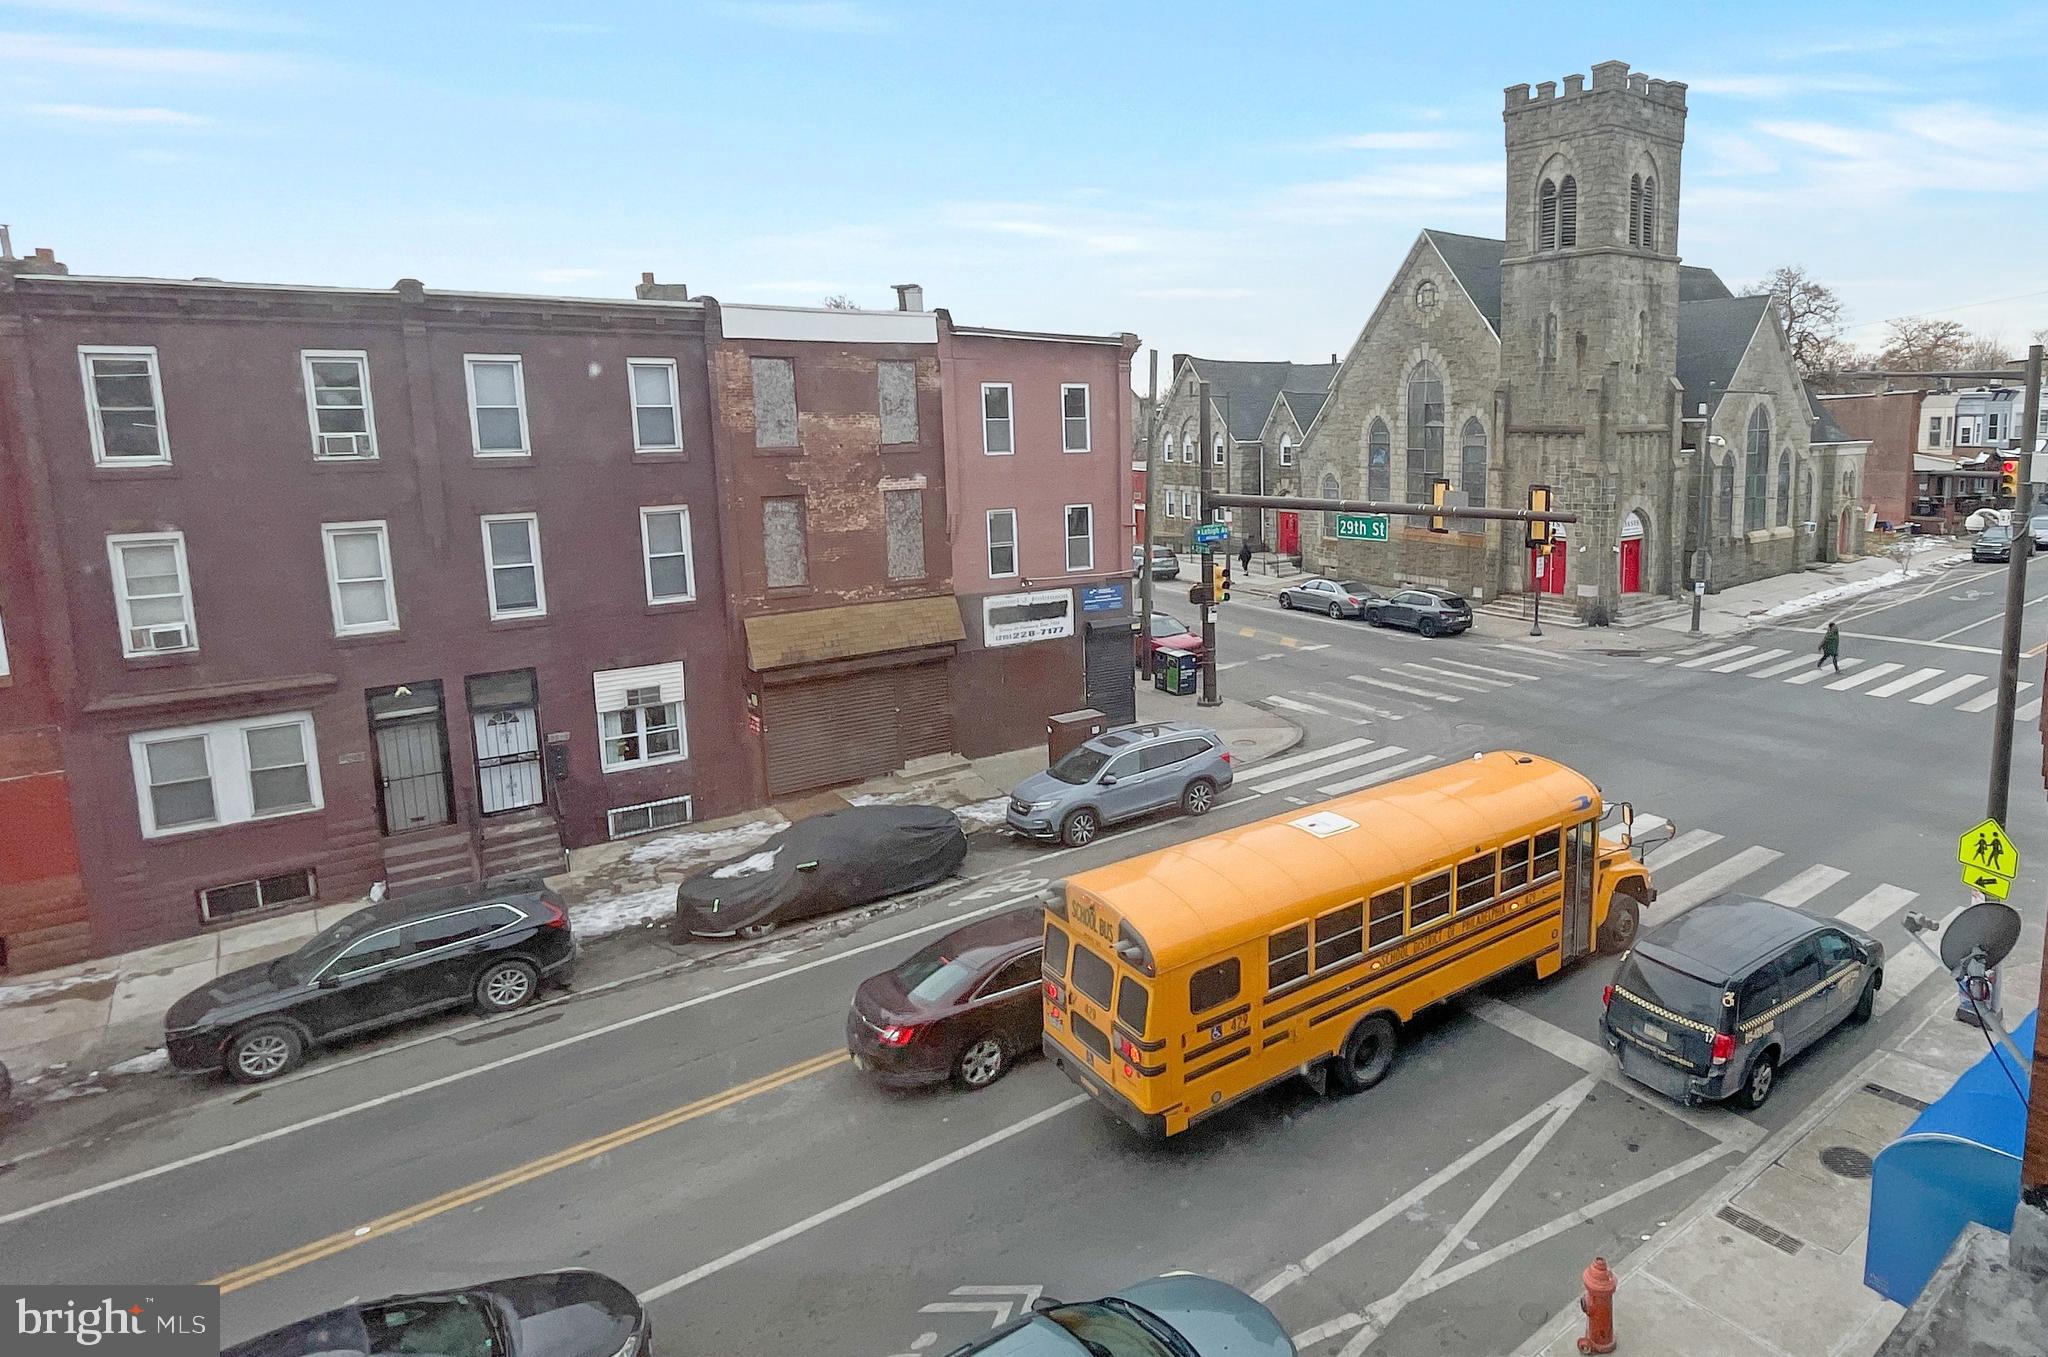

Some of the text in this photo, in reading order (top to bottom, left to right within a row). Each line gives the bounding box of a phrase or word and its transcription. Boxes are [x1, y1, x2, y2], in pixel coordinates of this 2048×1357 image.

[1340, 520, 1385, 537] 29th St
[1071, 899, 1098, 933] SCHOOL
[1099, 918, 1113, 943] BUS
[1380, 904, 1507, 968] SCHOOL DISTRICT OF PHILADELPHIA
[1230, 1013, 1249, 1031] 429
